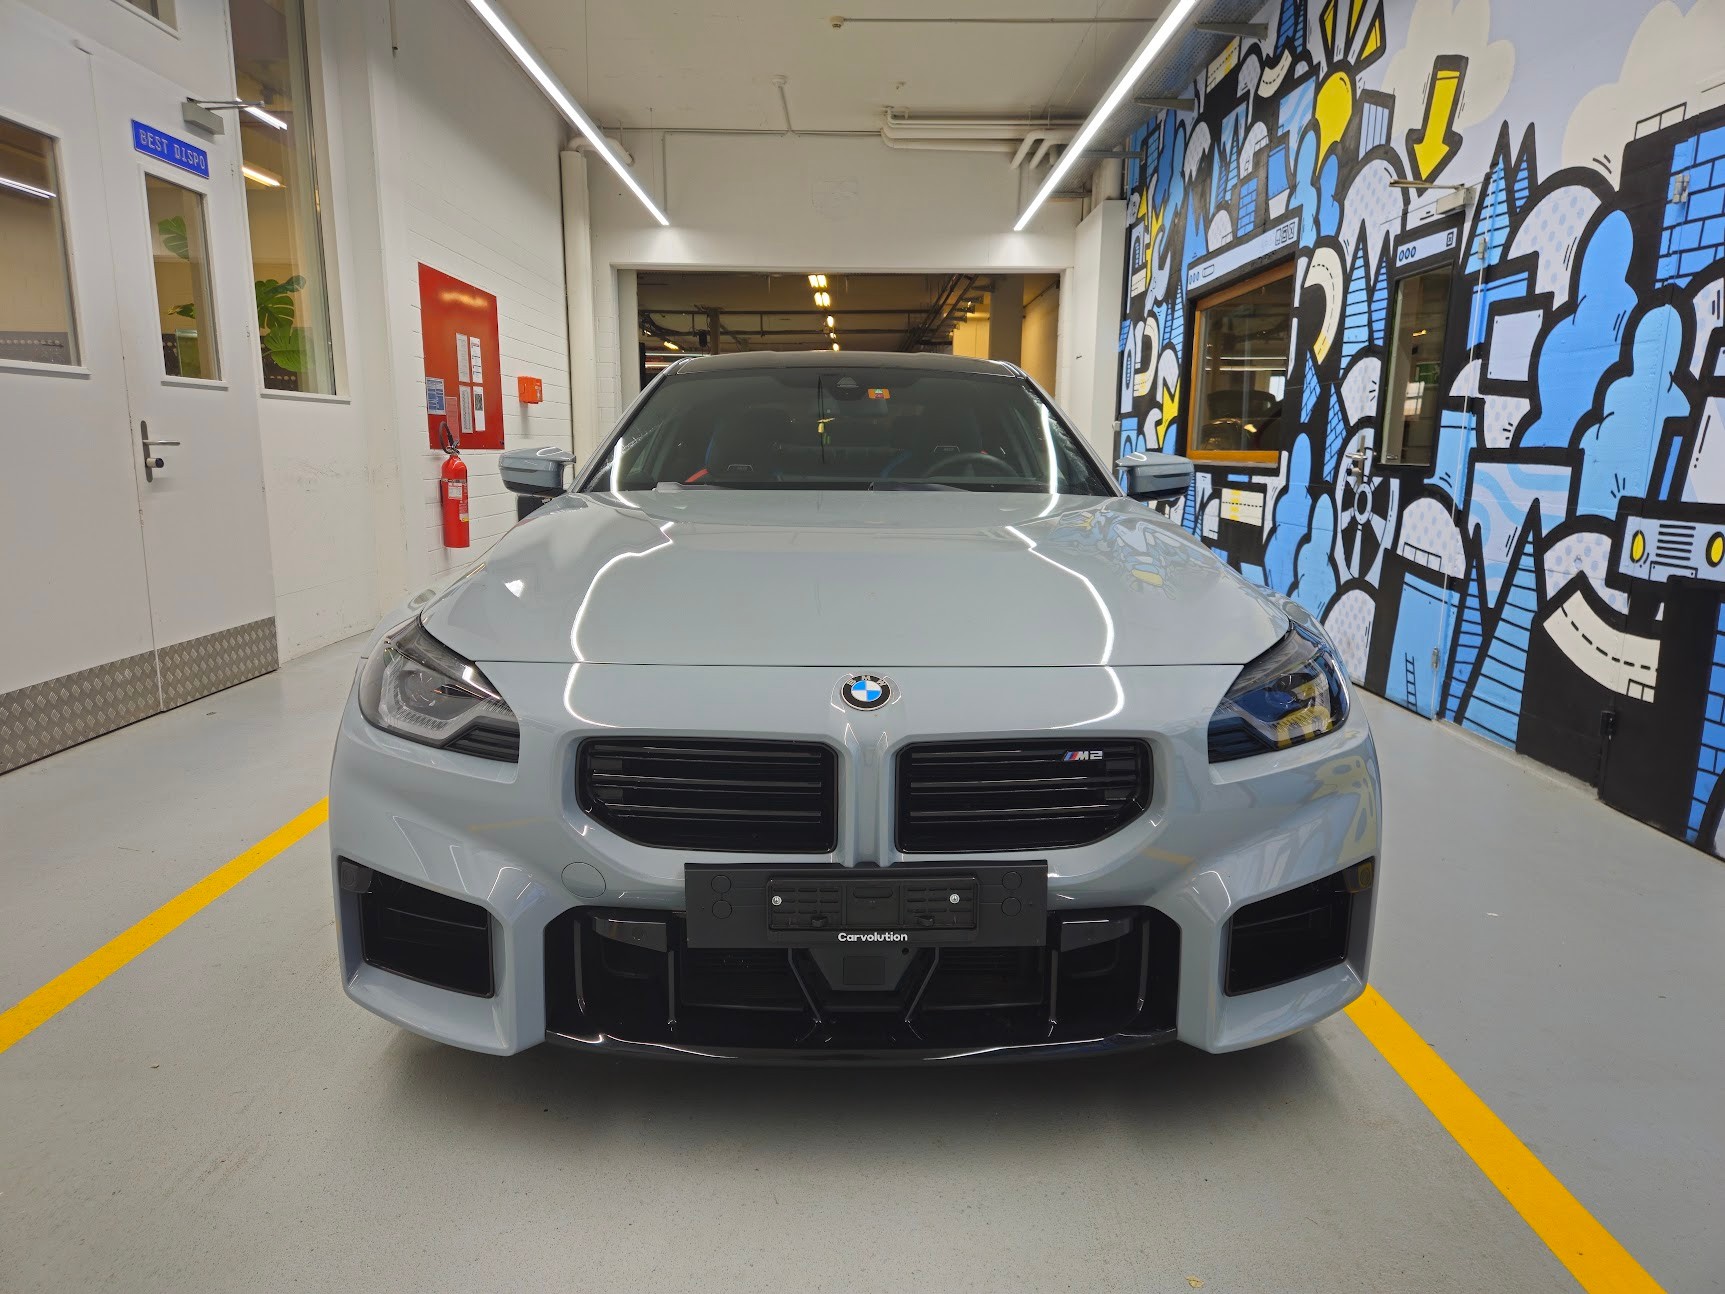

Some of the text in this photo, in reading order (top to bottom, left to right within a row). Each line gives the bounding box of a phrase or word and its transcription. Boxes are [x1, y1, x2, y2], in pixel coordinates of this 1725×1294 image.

[138, 129, 206, 170] BEST DISPO
[1071, 750, 1103, 760] M2
[837, 931, 908, 942] Carvolution
